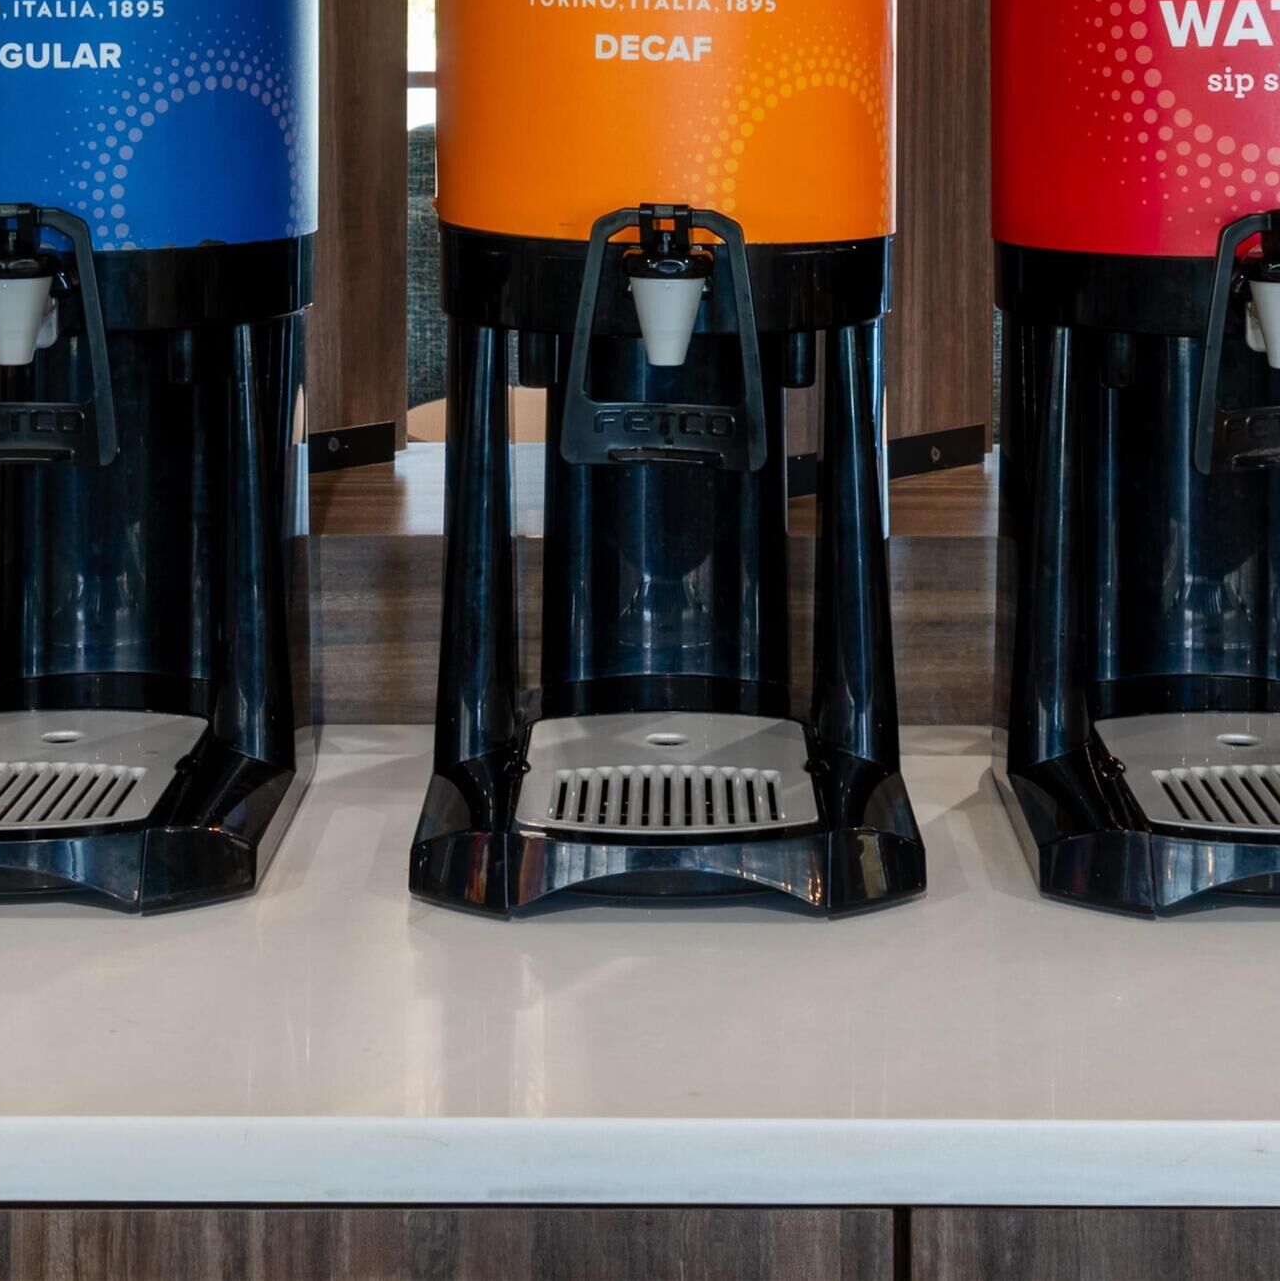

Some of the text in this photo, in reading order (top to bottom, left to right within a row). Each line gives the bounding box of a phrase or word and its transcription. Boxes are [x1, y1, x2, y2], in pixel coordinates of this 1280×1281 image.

[14, 0, 104, 19] ITALIA,
[108, 0, 165, 18] 1895
[594, 34, 713, 61] DECAF
[1207, 66, 1255, 98] sip
[594, 409, 736, 436] FETCO
